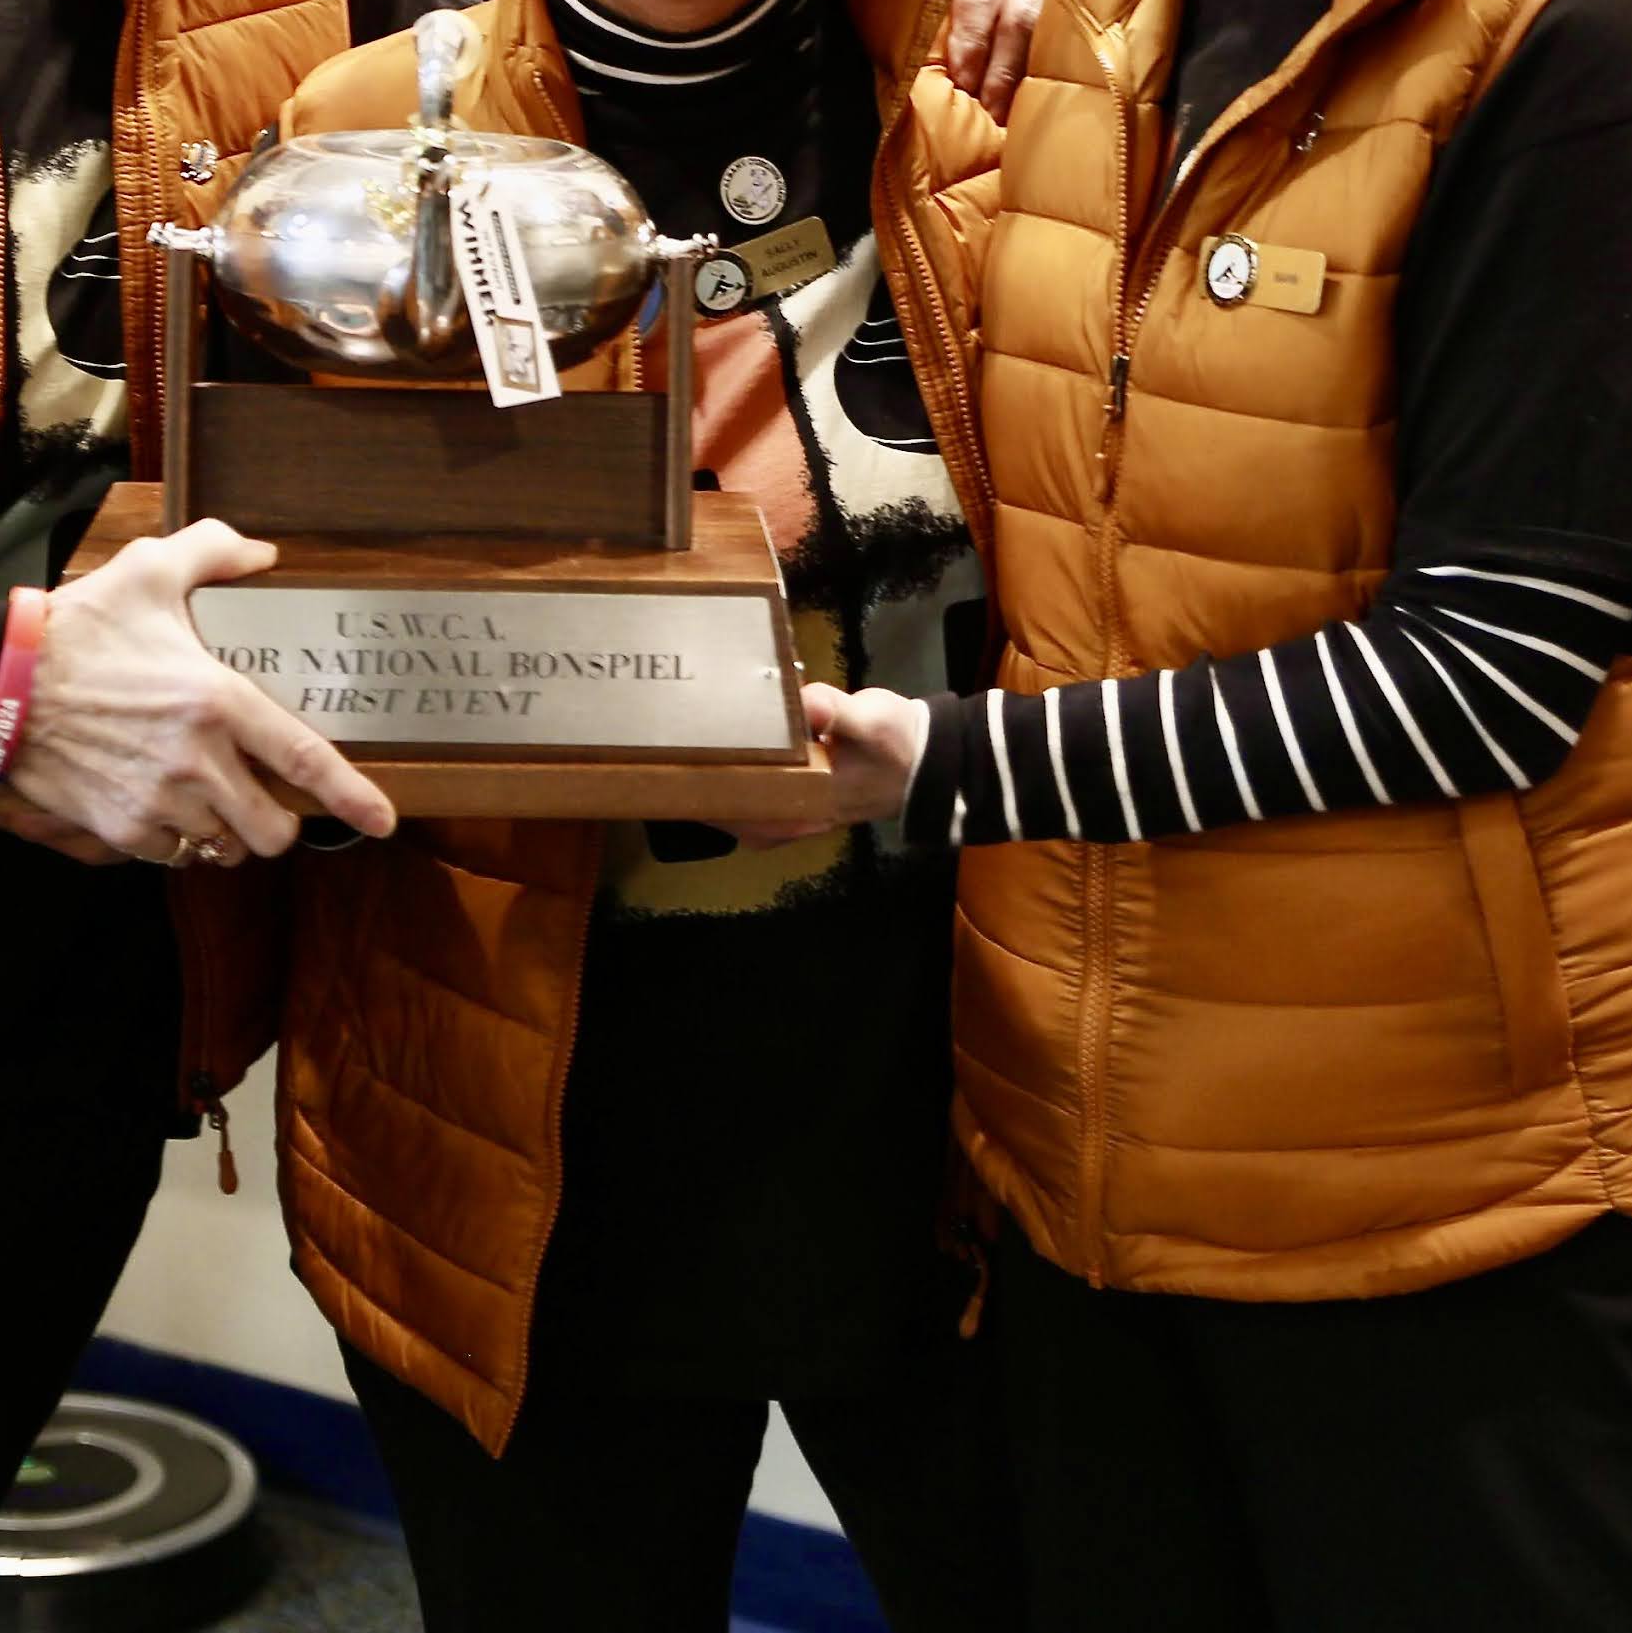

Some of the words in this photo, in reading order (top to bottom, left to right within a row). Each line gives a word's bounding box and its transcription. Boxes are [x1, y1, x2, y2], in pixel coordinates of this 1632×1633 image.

[459, 198, 497, 326] WINNER
[335, 611, 507, 642] U.S.W.C.A.
[301, 649, 491, 679] NATIONAL
[509, 653, 695, 681] BONSPIEL
[297, 687, 405, 713] FIRST
[414, 688, 540, 716] EVENT
